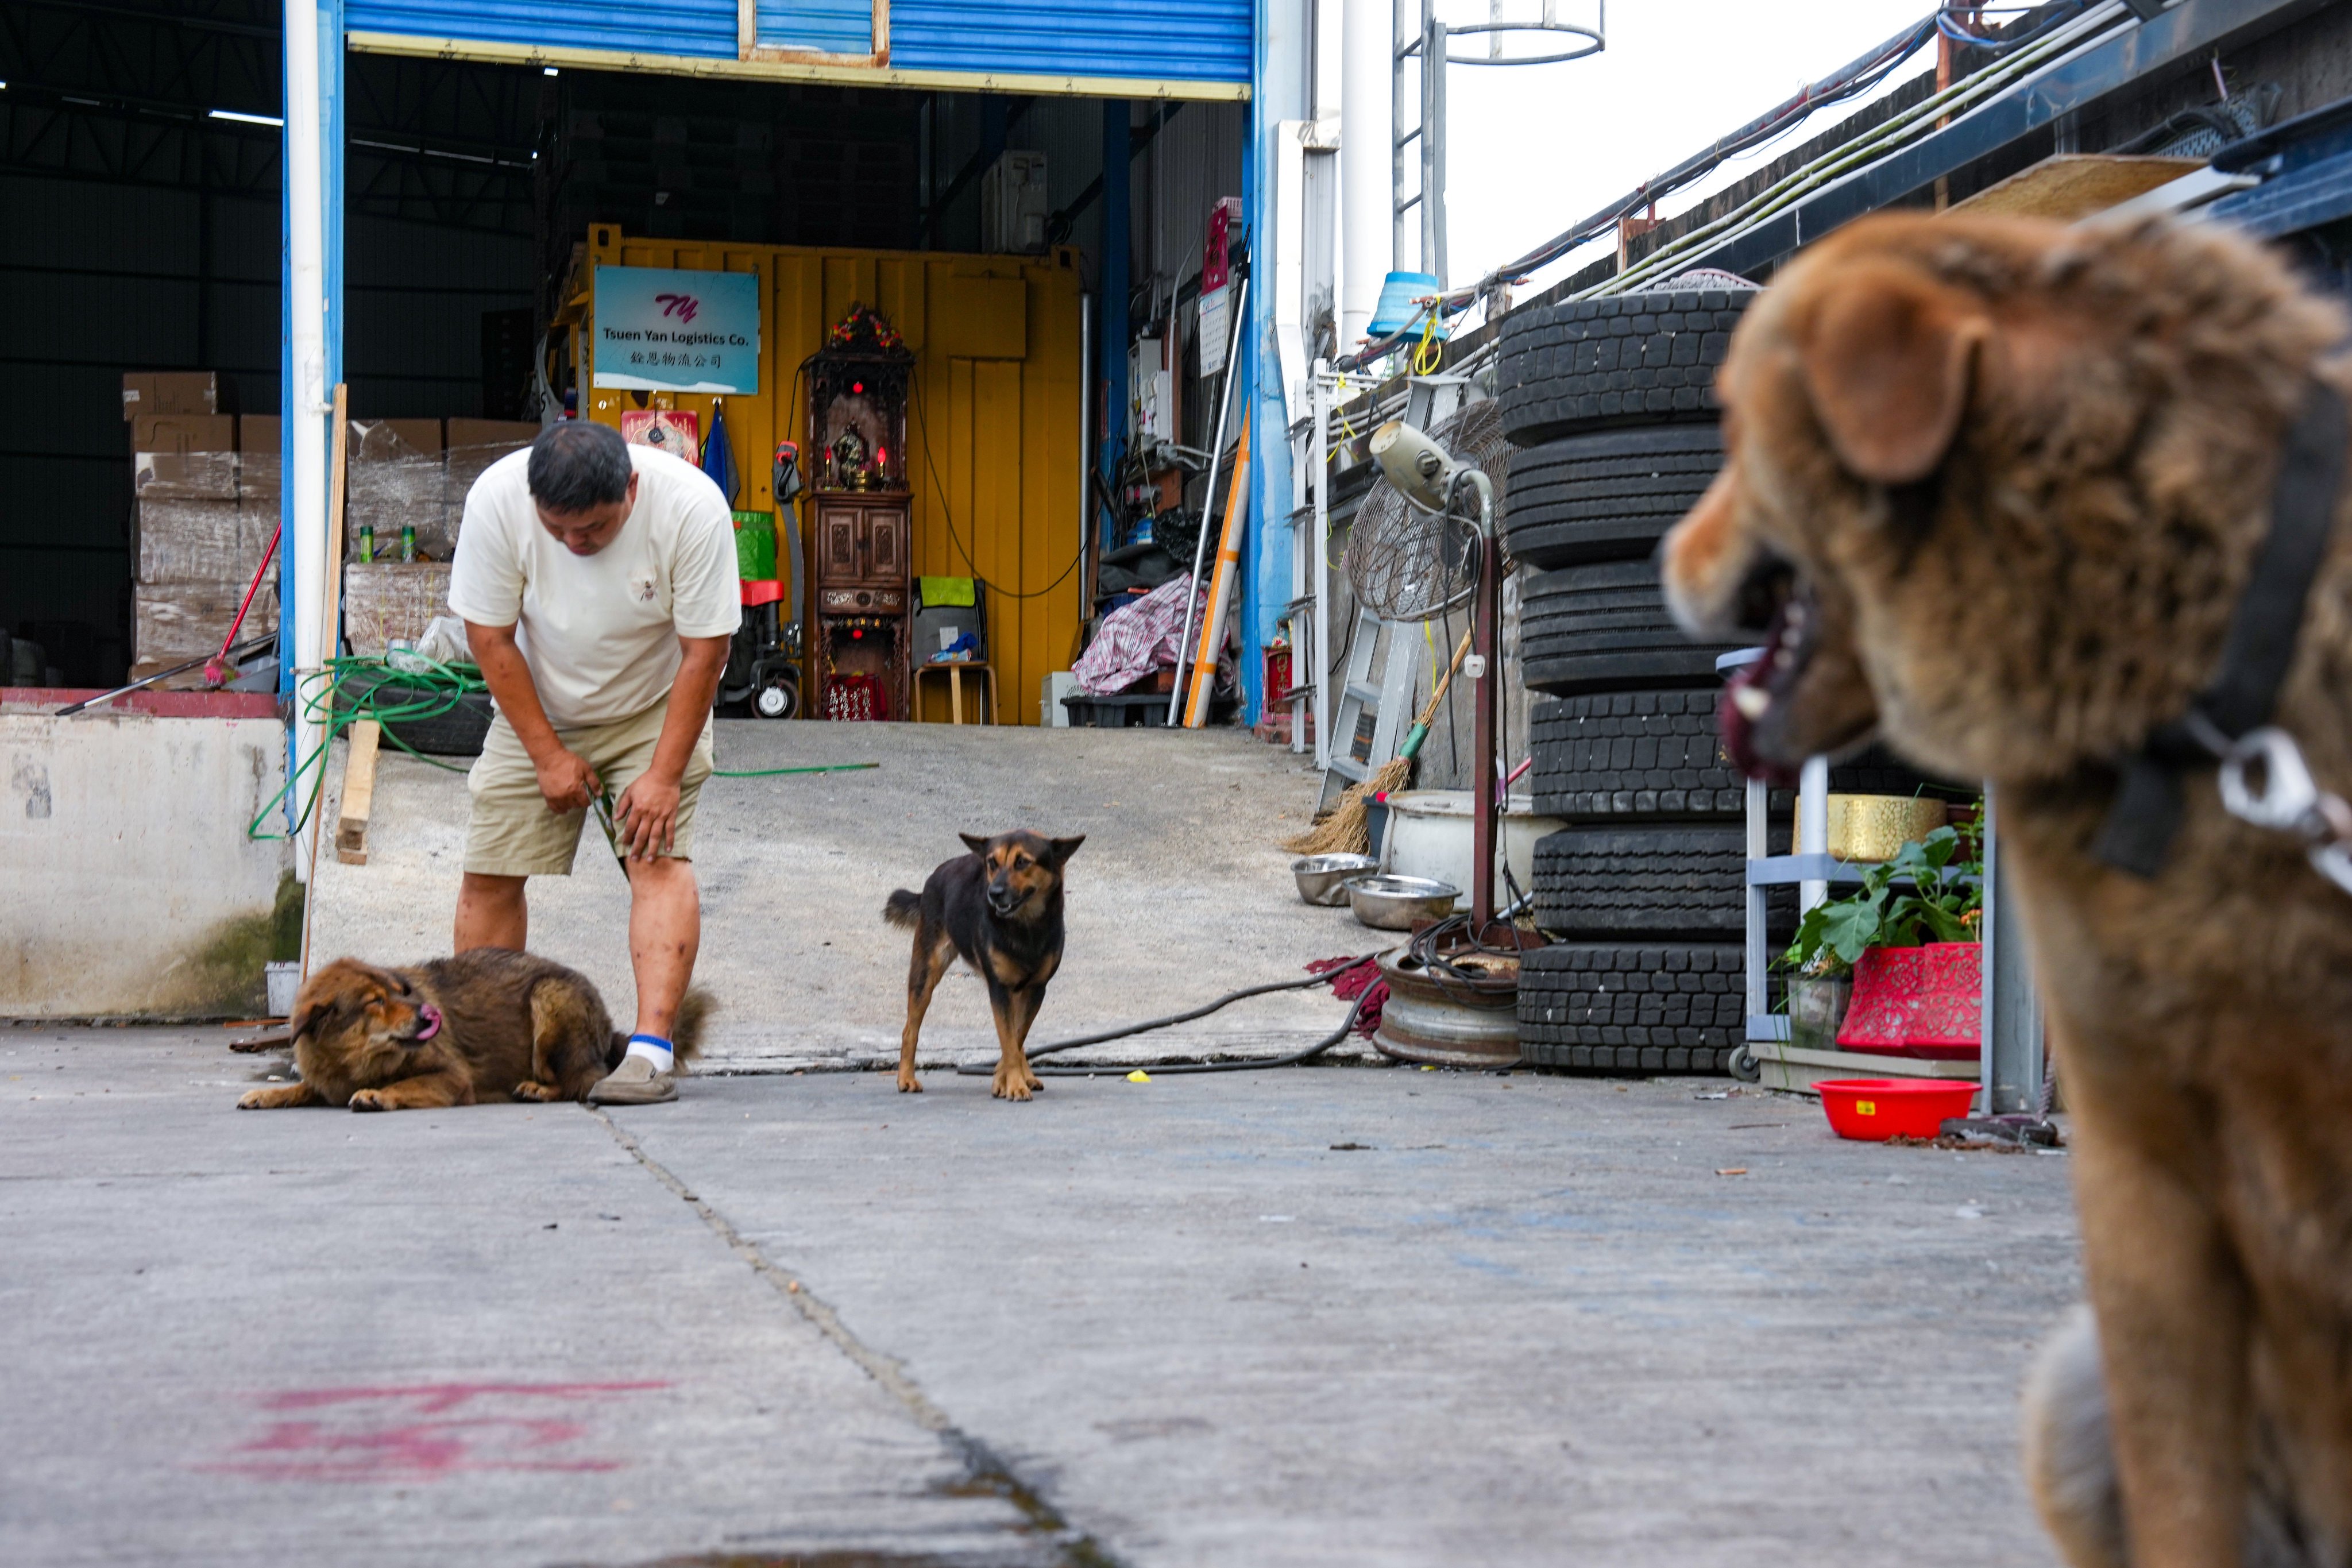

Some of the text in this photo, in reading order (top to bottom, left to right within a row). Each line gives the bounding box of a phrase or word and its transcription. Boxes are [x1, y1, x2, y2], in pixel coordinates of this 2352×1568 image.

[603, 327, 749, 346] Tsuen Yan Logistics Co.
